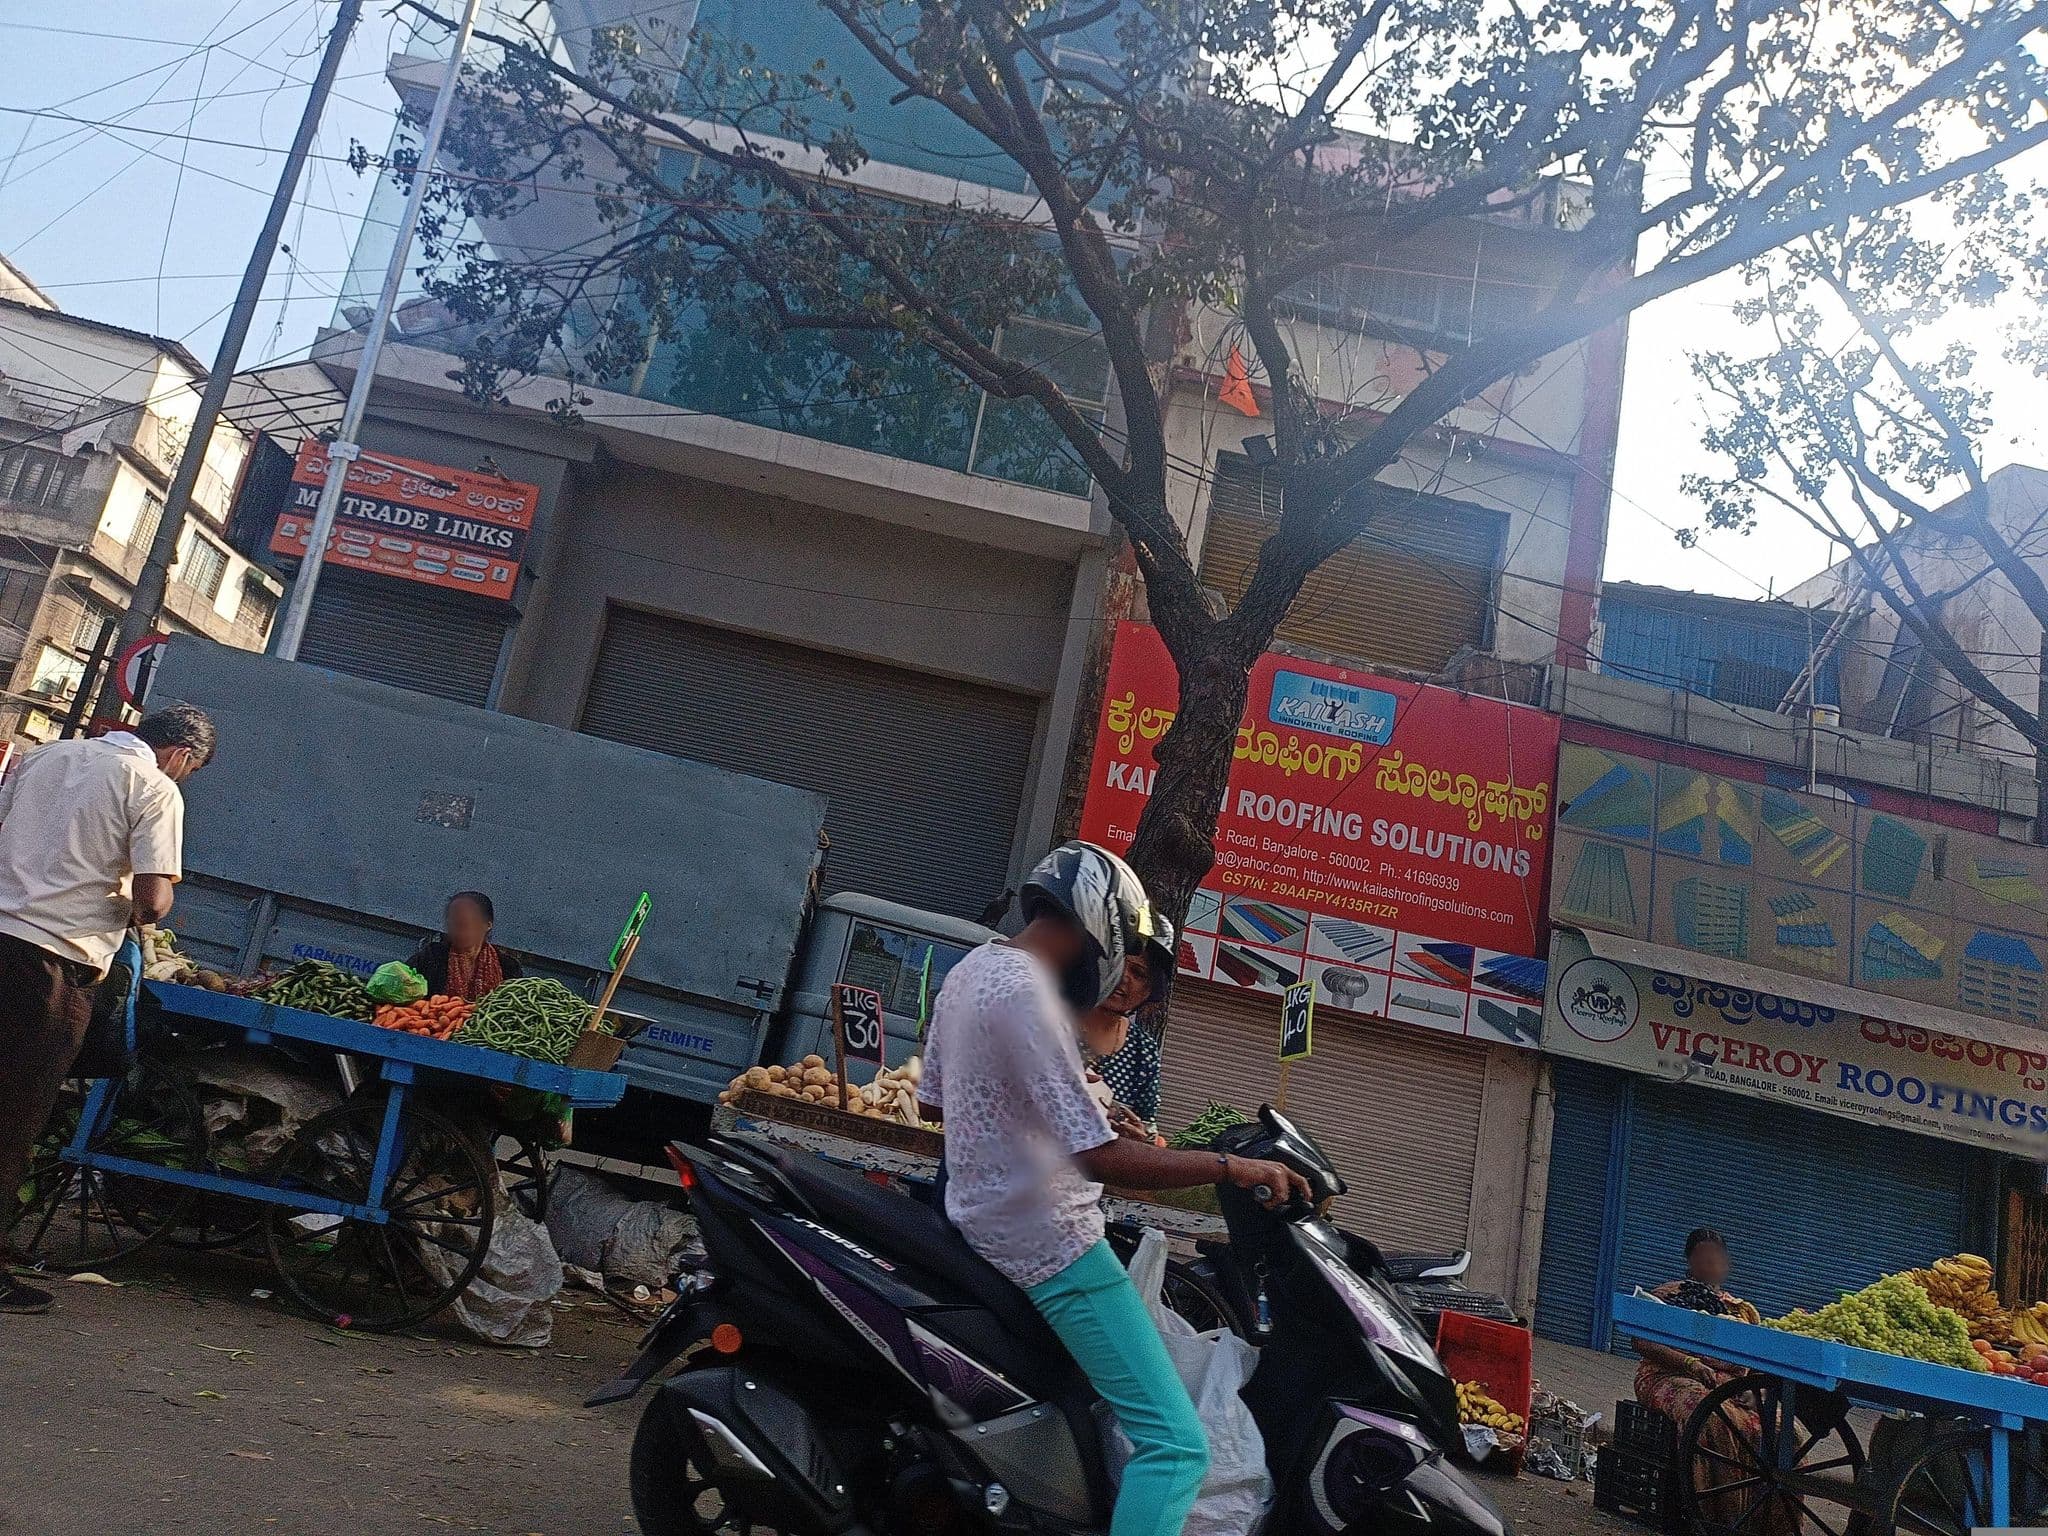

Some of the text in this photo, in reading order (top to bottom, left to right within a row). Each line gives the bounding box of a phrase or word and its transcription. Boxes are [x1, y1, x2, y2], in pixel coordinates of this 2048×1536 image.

[342, 497, 430, 531] TRADE
[435, 516, 513, 548] LINKS
[1277, 696, 1386, 733] KAILASH
[1279, 715, 1332, 733] INNOVATIVE
[1236, 789, 1532, 877] ROOFING SOLUTIONS
[1226, 829, 1259, 850] Road,
[1262, 837, 1319, 861] Bangalore
[1328, 851, 1373, 873] 560002.
[1404, 868, 1460, 892] 41696939
[1222, 871, 1269, 892] GSTIN:
[1303, 867, 1514, 925] http://www.kailashroofingsolutions.com
[843, 1010, 880, 1048] 30
[1283, 1009, 1307, 1047] 40
[1649, 1021, 2048, 1133] VICEROY ROOFINGS
[1729, 1074, 1777, 1093] BANGALORE
[1783, 1086, 1812, 1100] 560002.
